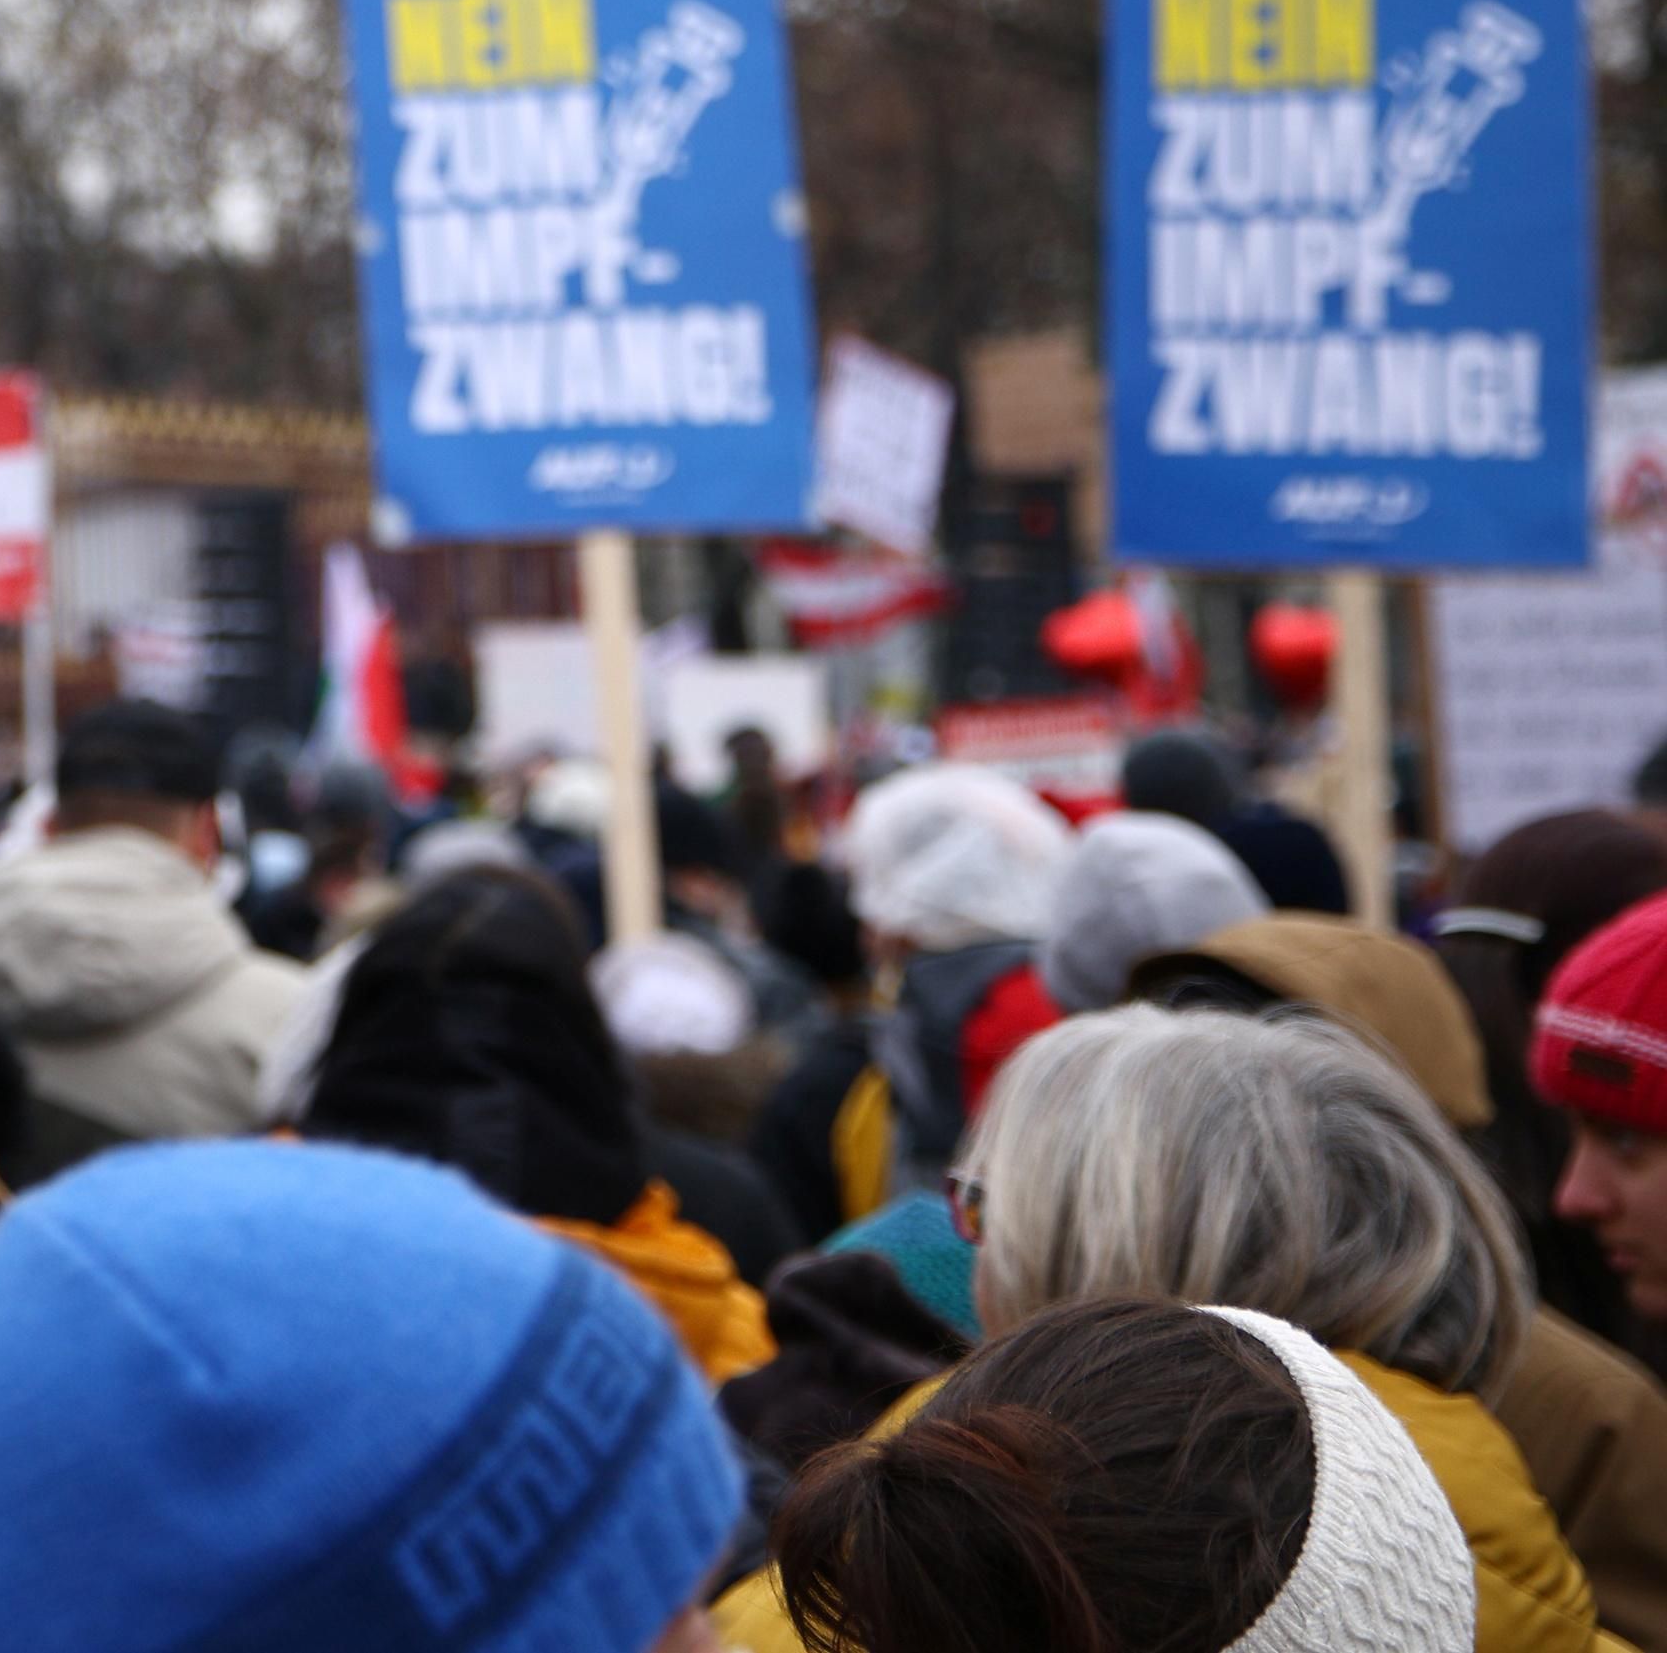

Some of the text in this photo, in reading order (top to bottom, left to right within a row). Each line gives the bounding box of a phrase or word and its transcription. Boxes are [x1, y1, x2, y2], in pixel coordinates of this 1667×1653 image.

[394, 89, 599, 201] ZUM
[1150, 92, 1377, 217] ZUM
[409, 305, 769, 434] ZWANG!
[1149, 328, 1543, 459] ZWANG!
